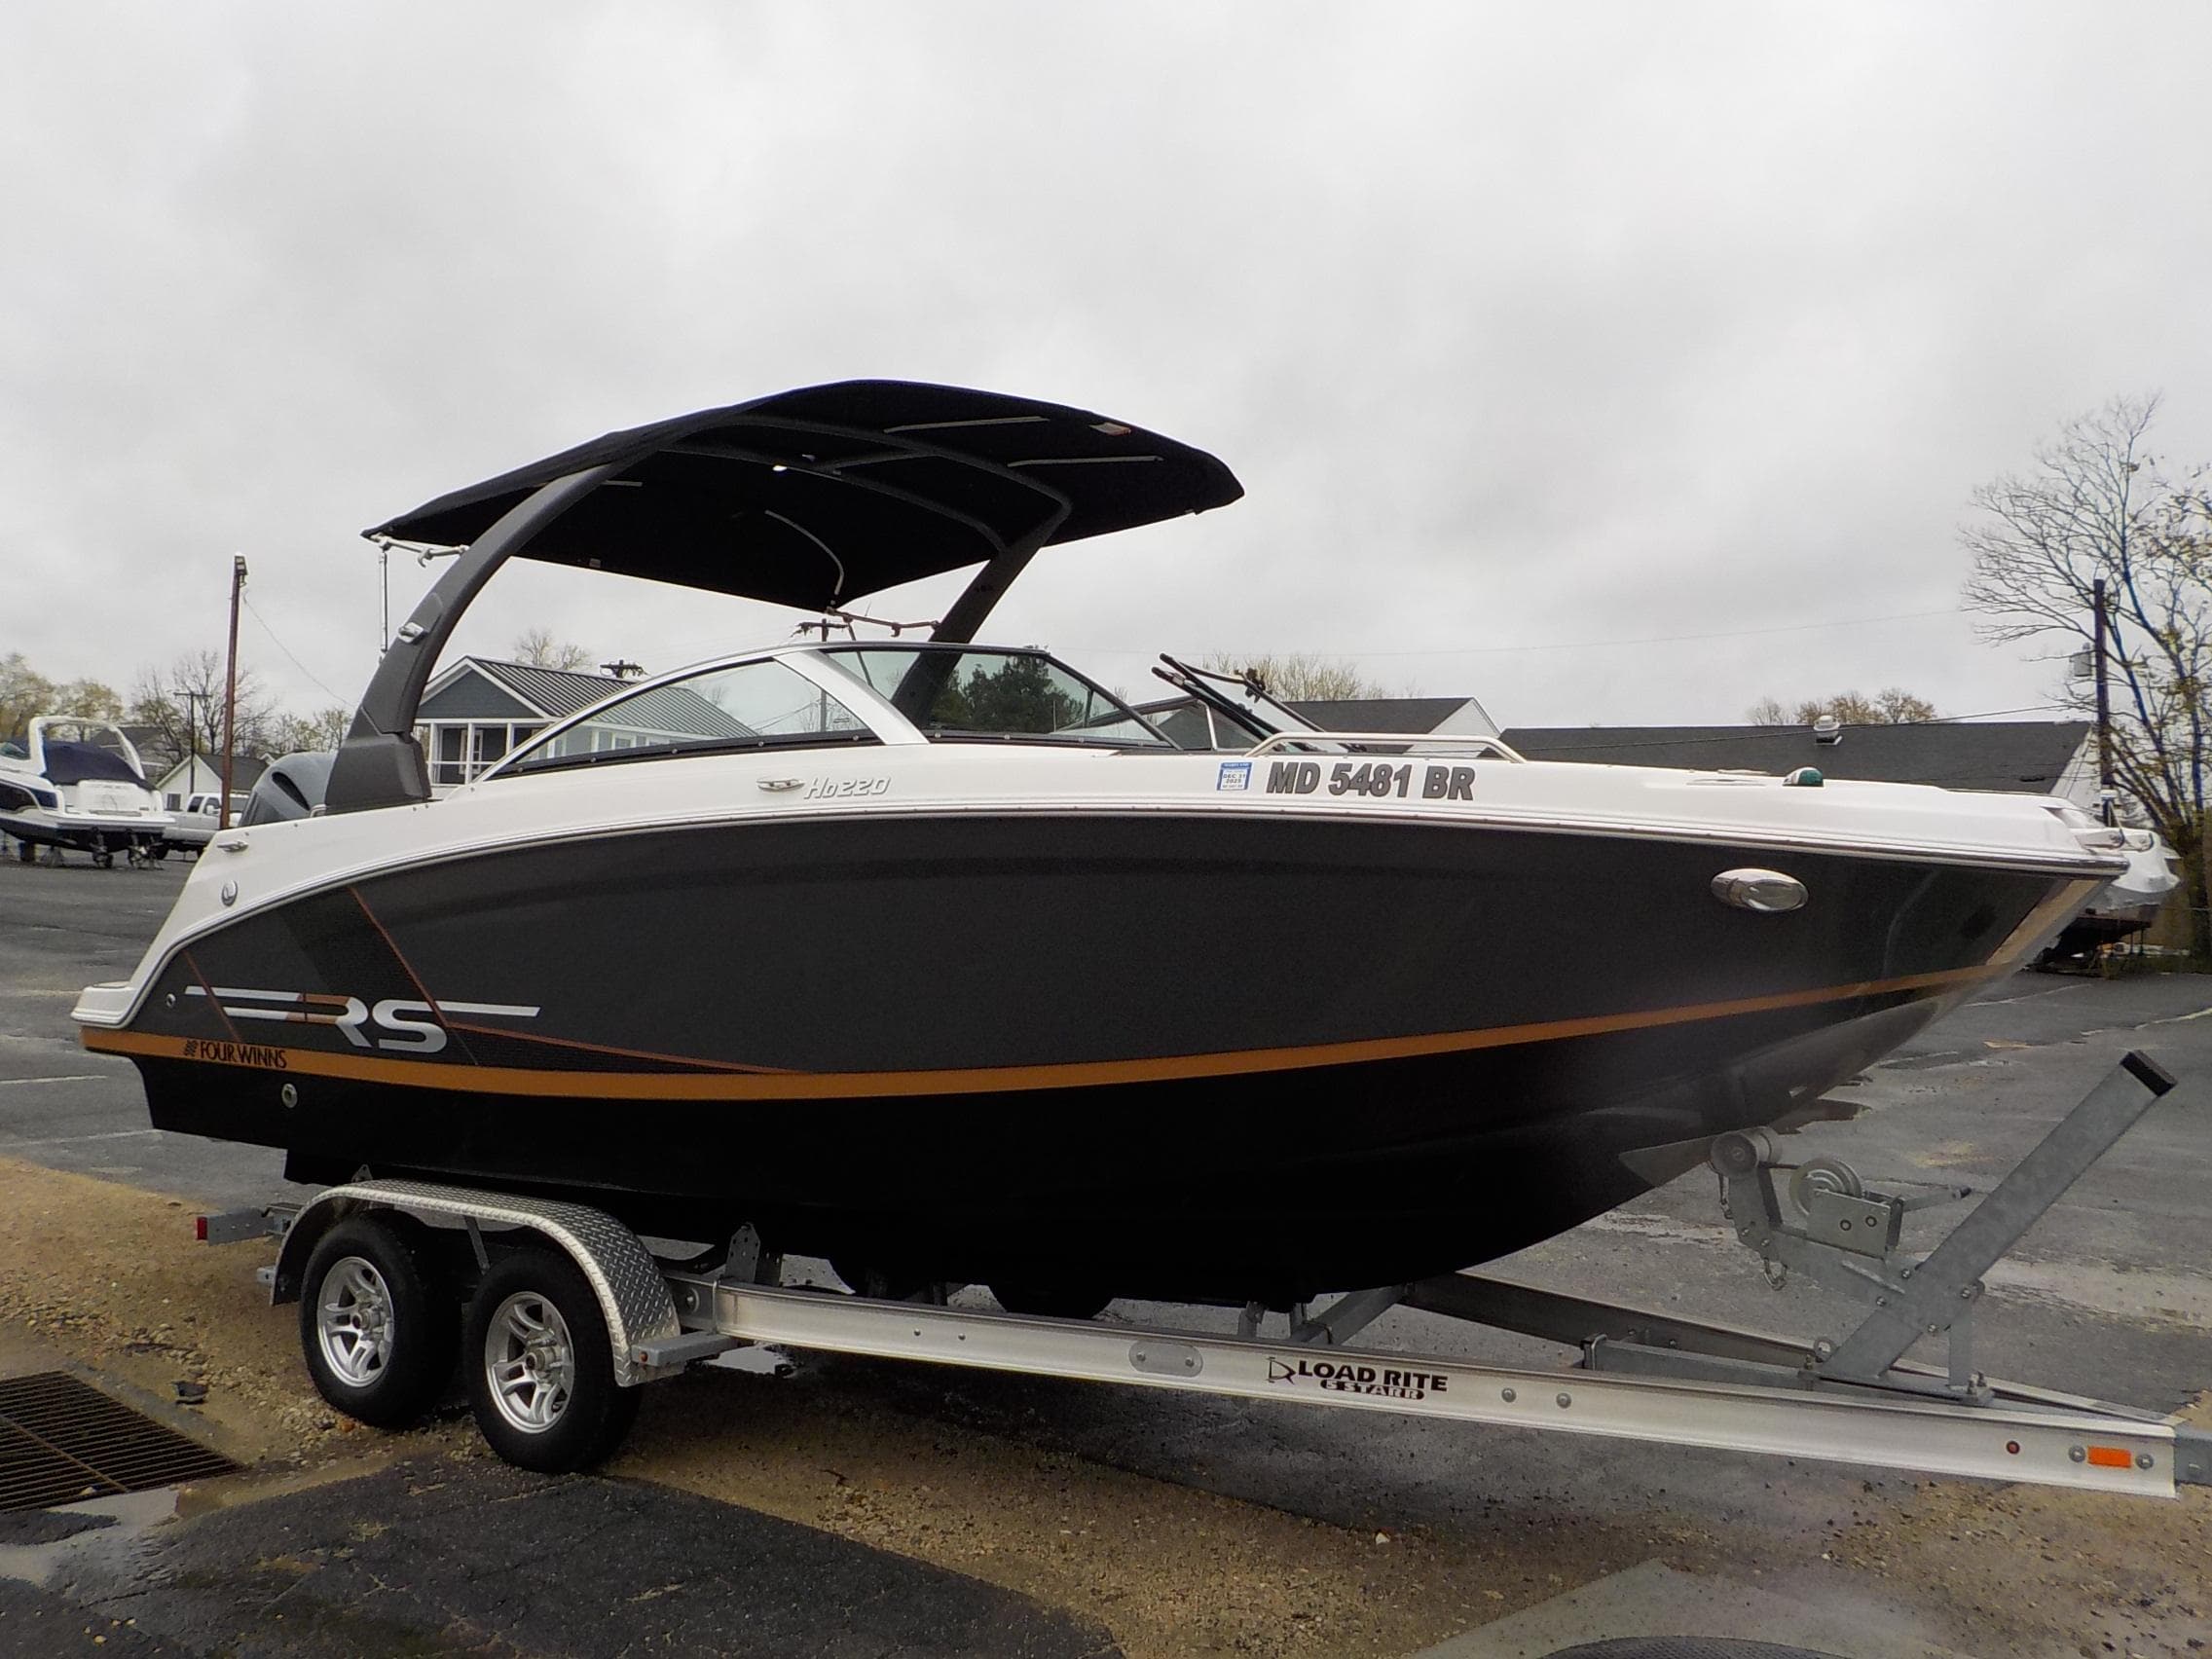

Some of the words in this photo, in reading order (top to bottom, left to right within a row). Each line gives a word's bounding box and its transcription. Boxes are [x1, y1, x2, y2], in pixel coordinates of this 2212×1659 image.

[1267, 761, 1320, 794] MD
[1328, 762, 1413, 798] 5481
[1422, 765, 1475, 801] BR
[200, 1041, 237, 1063] FOUR
[237, 1045, 287, 1069] WINNS
[1298, 1359, 1376, 1383] LOAD
[1382, 1369, 1449, 1392] RITE
[1343, 1380, 1419, 1400] STARR
